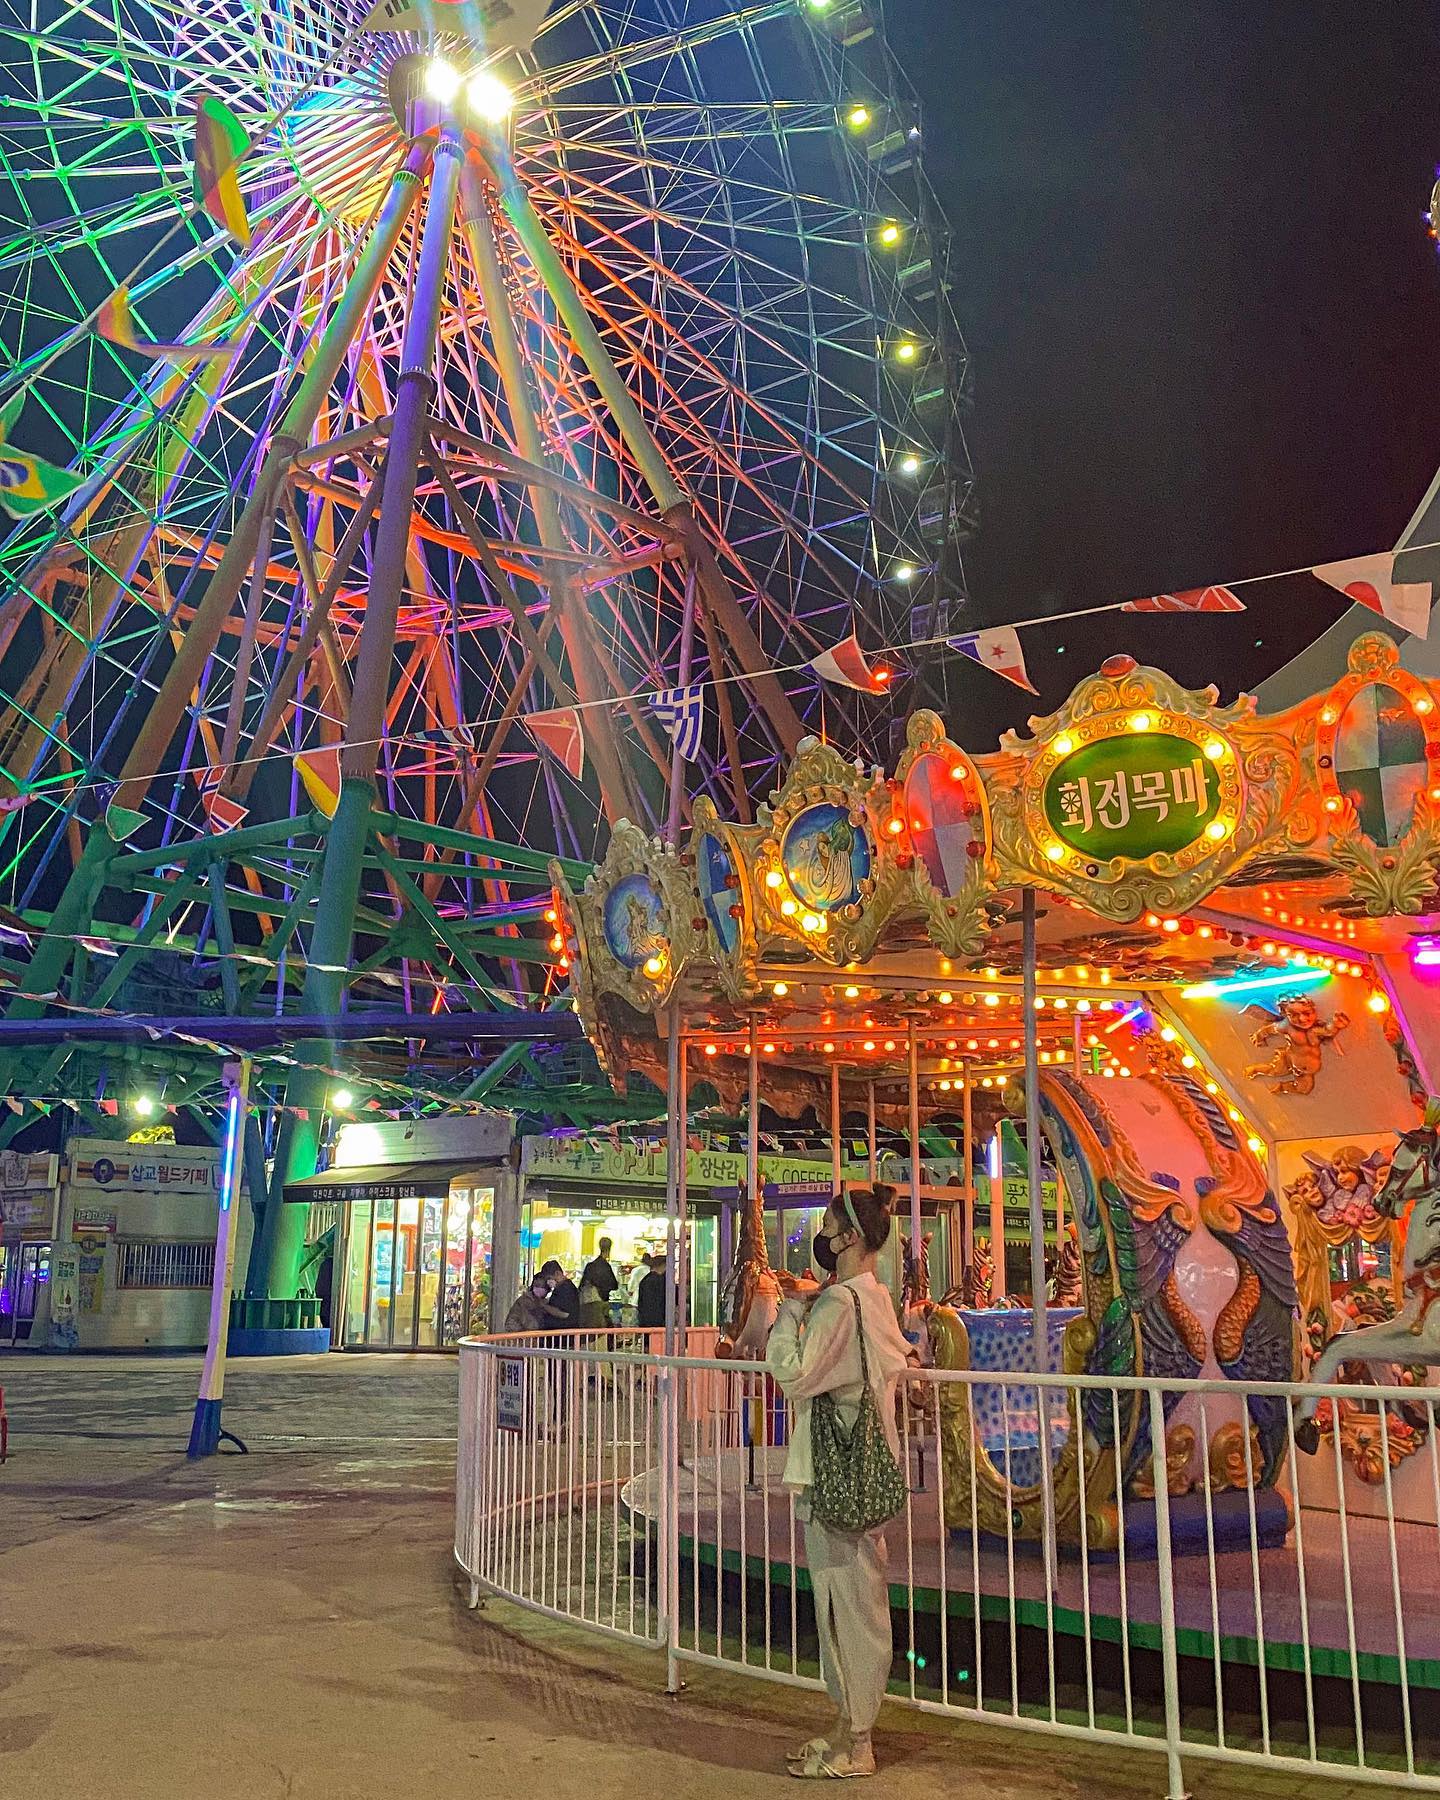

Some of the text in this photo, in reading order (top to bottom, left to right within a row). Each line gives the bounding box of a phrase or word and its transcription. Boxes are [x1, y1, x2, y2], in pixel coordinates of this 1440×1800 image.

[1058, 759, 1209, 833] 회전목마
[700, 1156, 740, 1180] 장난감
[507, 1363, 519, 1386] 위험
